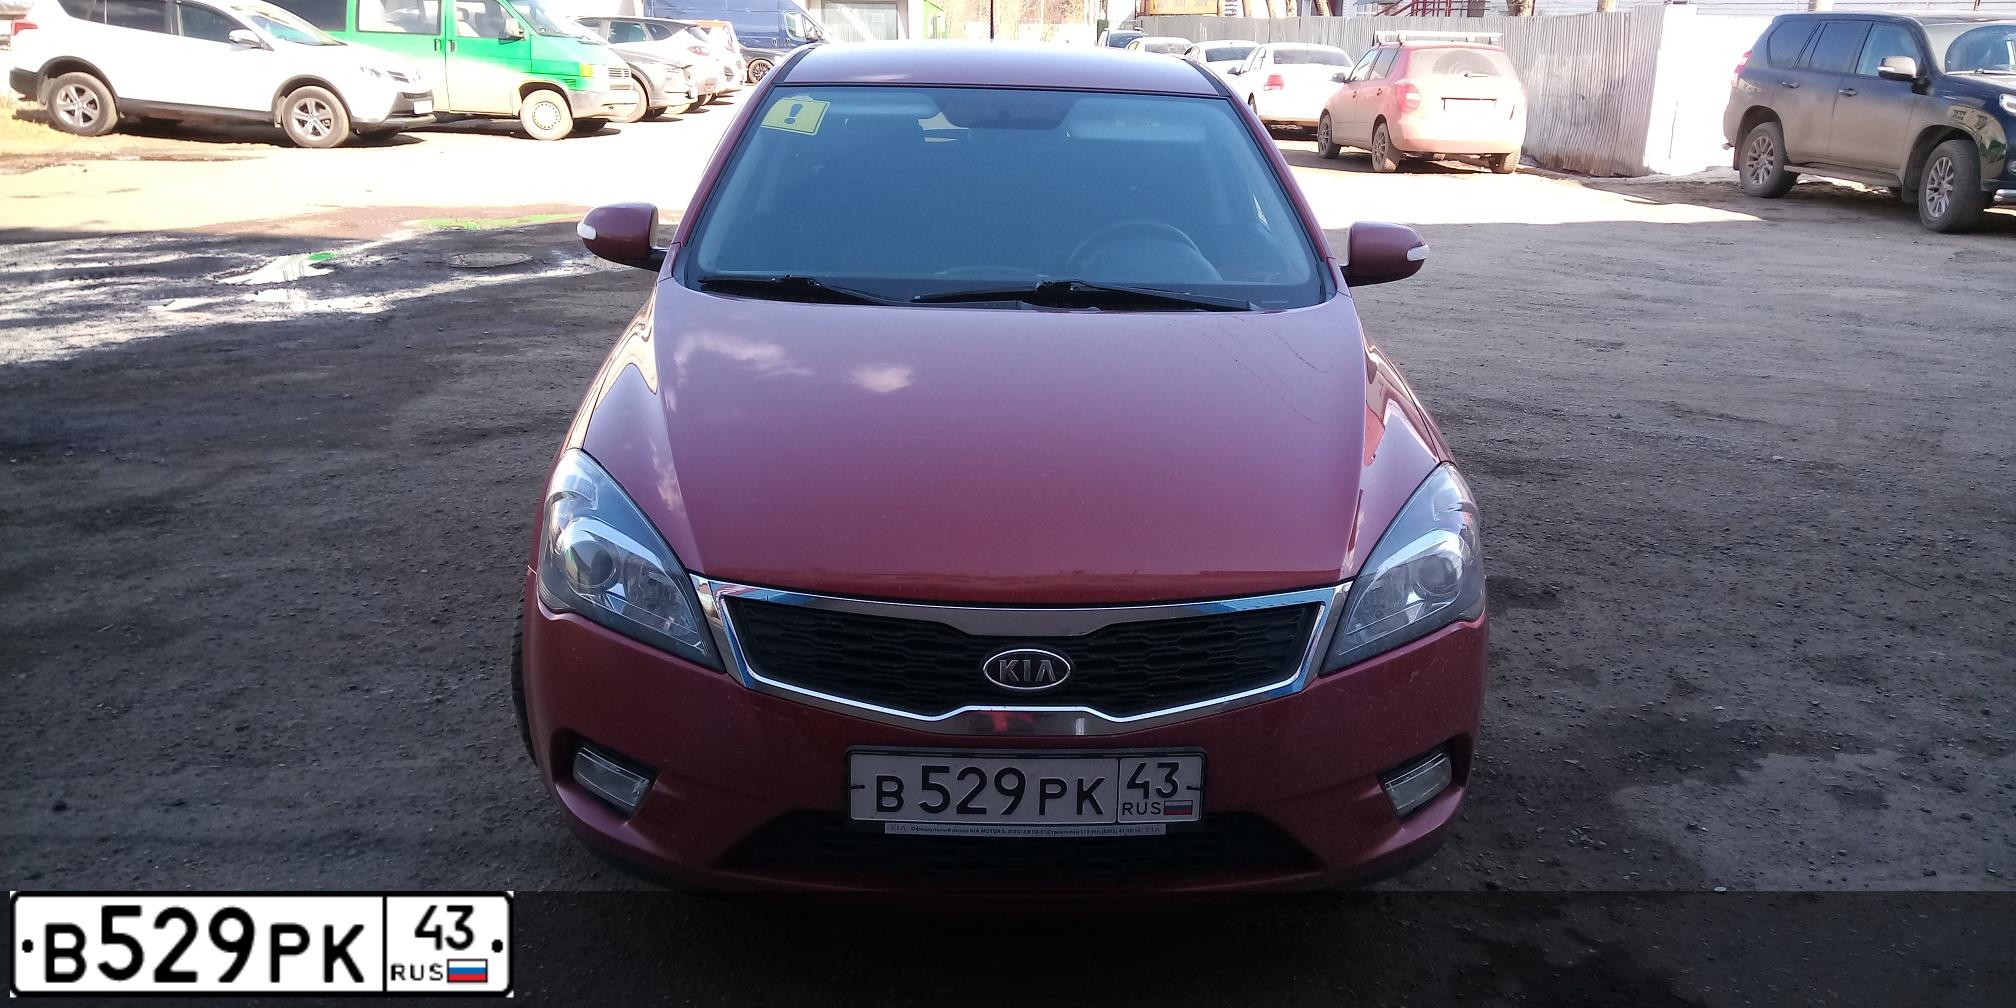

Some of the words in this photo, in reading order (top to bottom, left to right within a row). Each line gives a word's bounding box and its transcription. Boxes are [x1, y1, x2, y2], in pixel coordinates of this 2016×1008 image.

[999, 659, 1057, 681] KIA
[1126, 762, 1180, 799] 43
[1122, 801, 1162, 816] RUS
